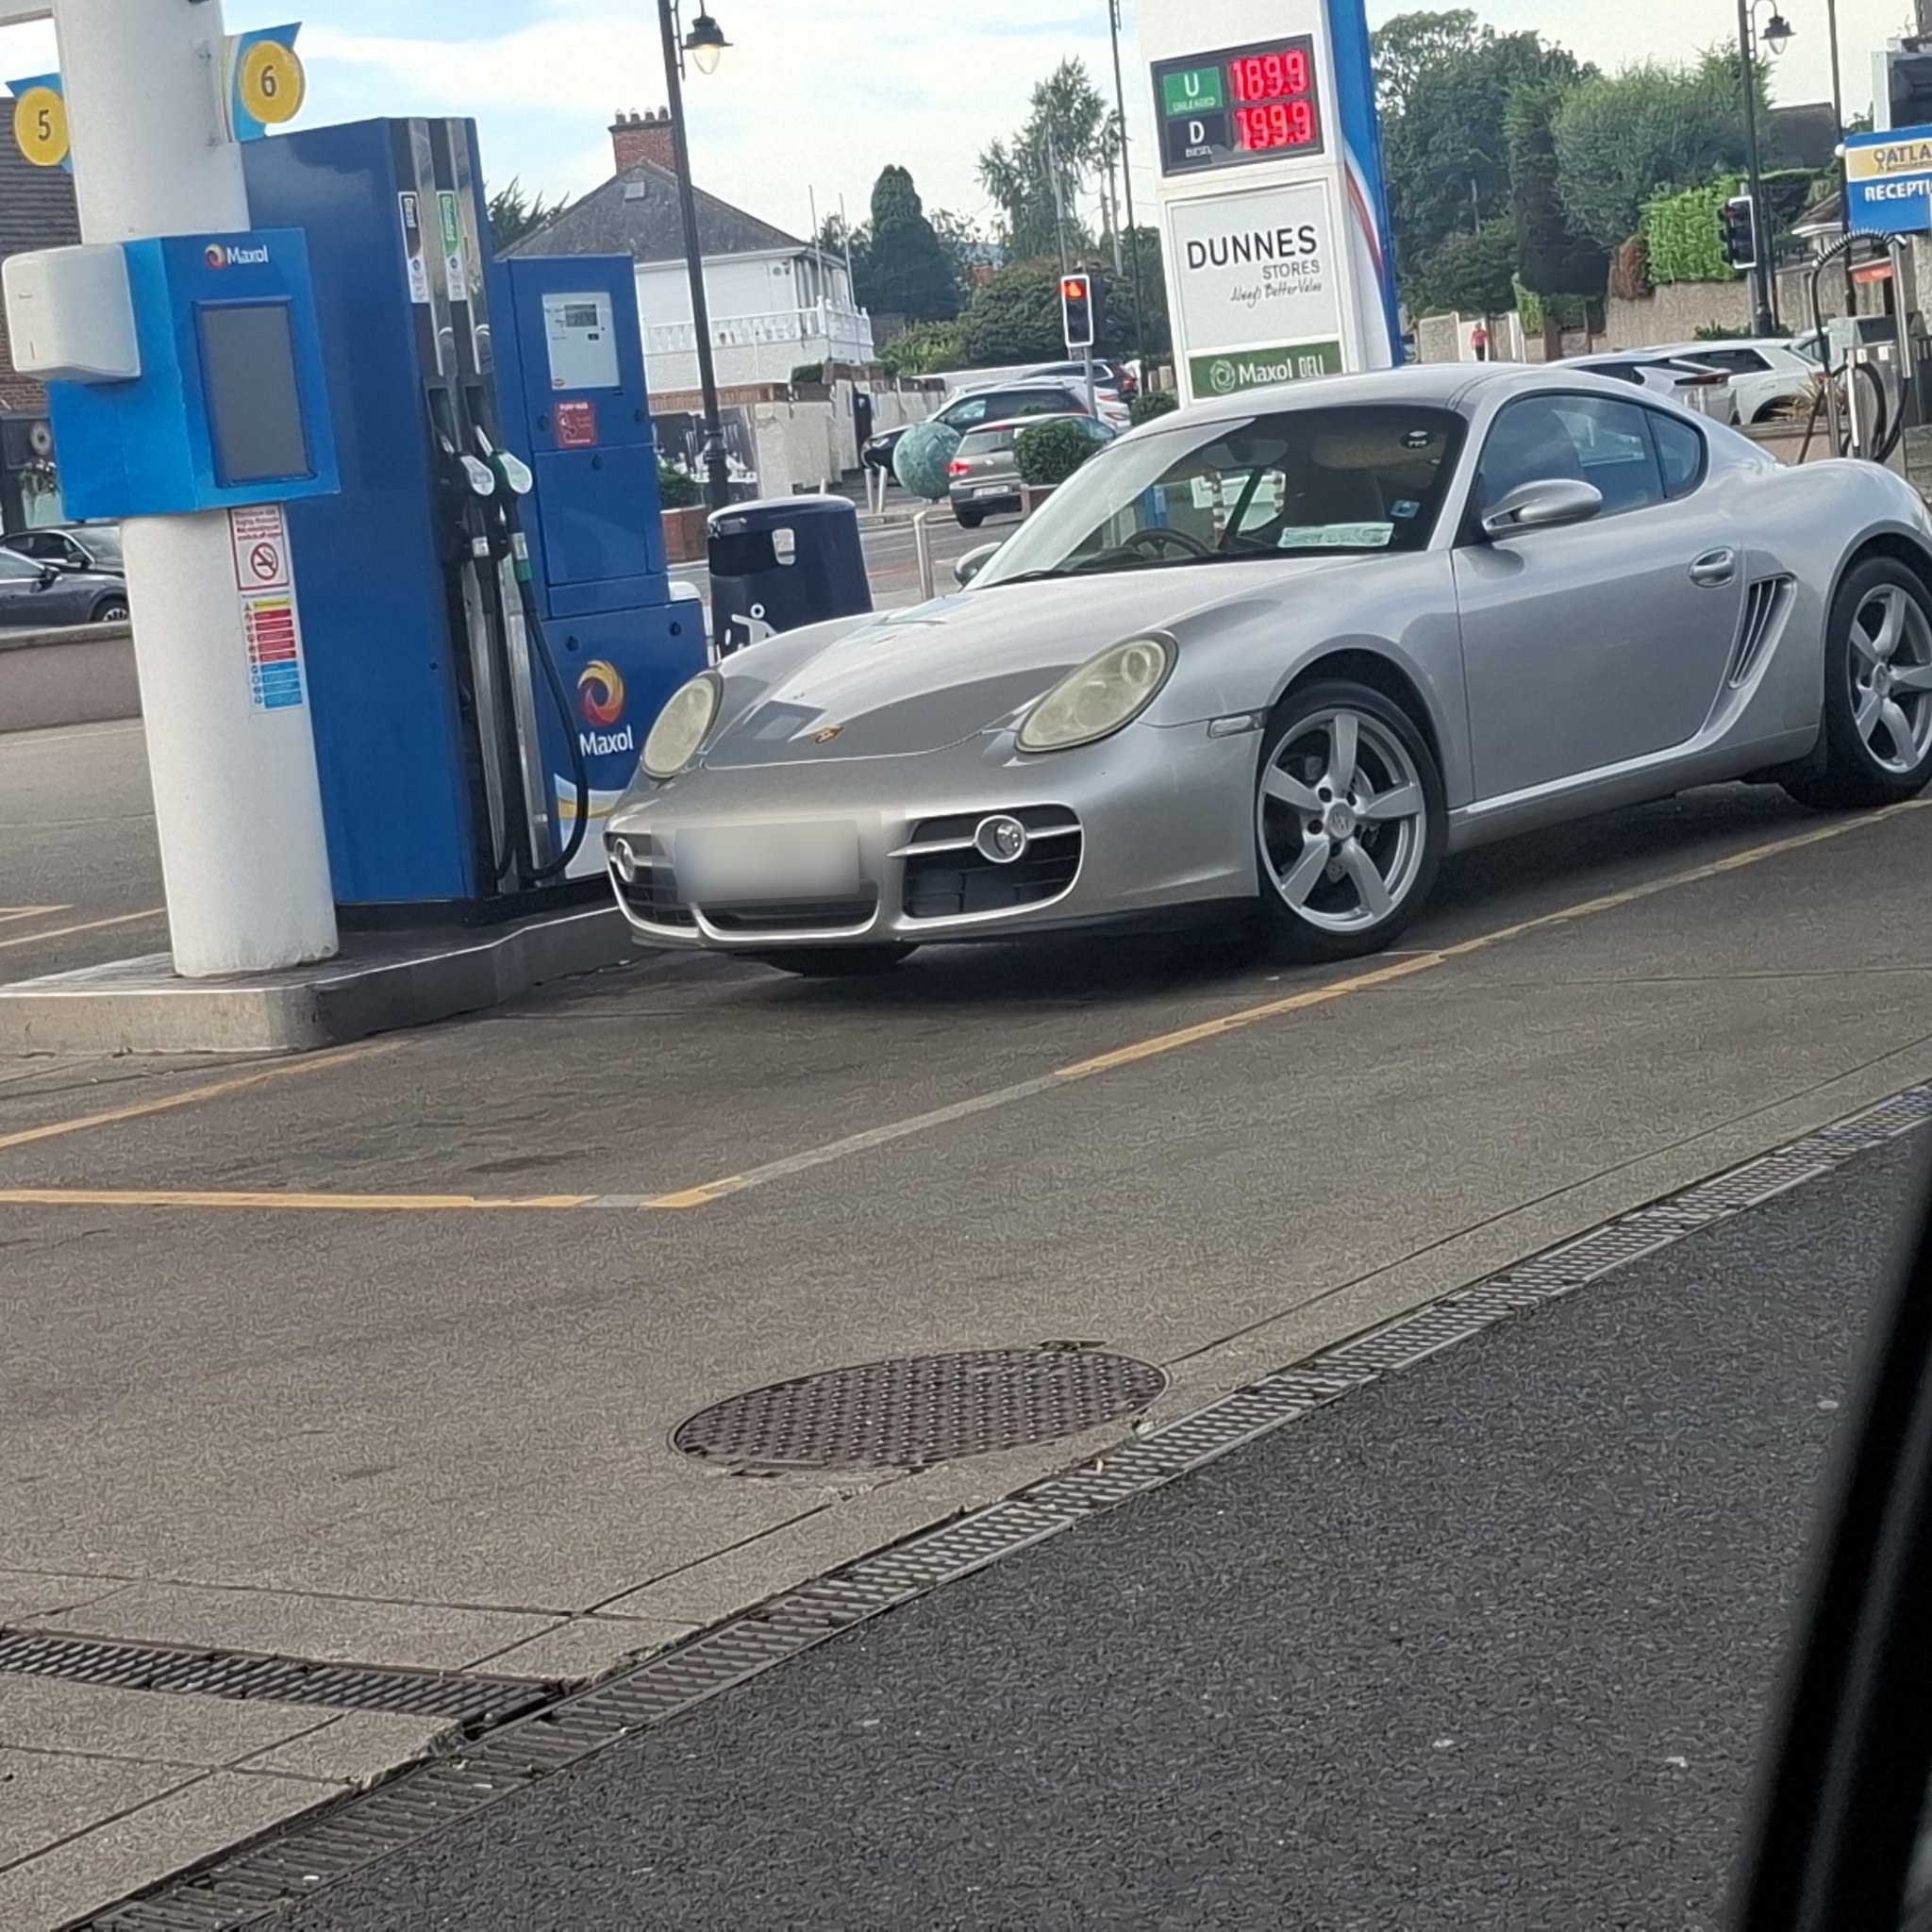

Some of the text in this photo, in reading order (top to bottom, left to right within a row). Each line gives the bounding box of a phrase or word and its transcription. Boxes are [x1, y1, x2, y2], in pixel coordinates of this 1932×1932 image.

[259, 65, 277, 97] 6
[1184, 73, 1199, 96] U
[37, 108, 52, 142] 5
[1189, 121, 1205, 144] D
[1185, 145, 1213, 158] DIESEL
[1864, 177, 1932, 202] RECEPTI
[226, 245, 269, 265] Maxol
[1187, 225, 1317, 270] DUNNES
[1261, 259, 1321, 280] STORES
[1238, 358, 1293, 385] Maxol
[579, 724, 634, 757] Maxol
